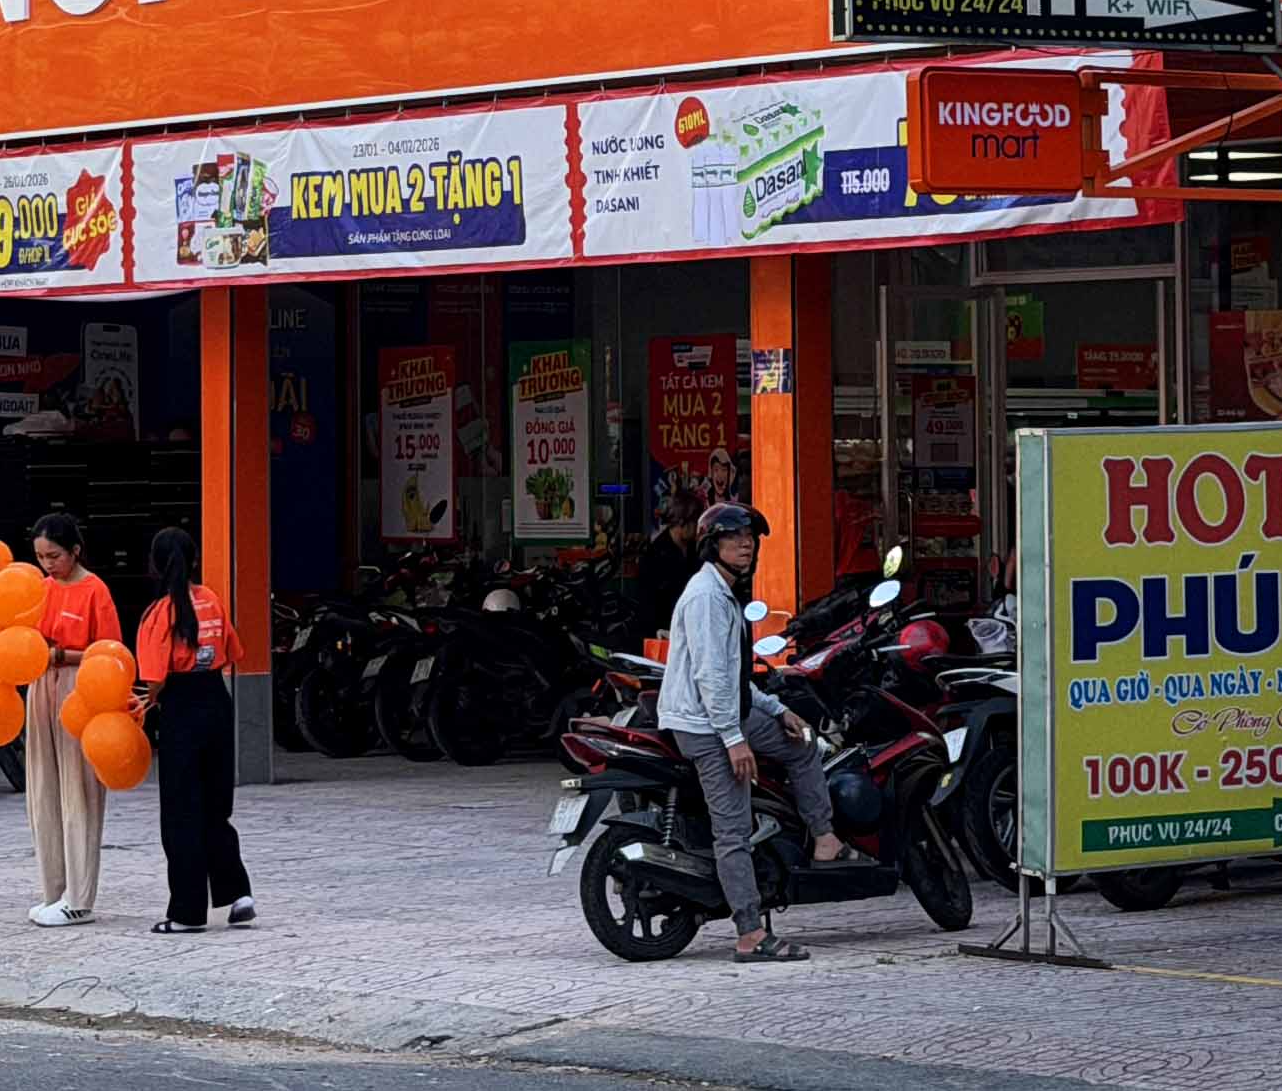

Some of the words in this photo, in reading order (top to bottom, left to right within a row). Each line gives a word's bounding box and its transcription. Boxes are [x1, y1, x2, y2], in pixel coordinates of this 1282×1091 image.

[938, 100, 1071, 128] KINGFOOD
[591, 135, 628, 155] NƯỚC
[971, 132, 1040, 159] mart
[593, 168, 620, 185] TINH
[622, 161, 659, 182] KHIẾT
[290, 170, 344, 220] KEM
[348, 165, 403, 216] MUA
[407, 163, 426, 213] 2
[430, 151, 502, 225] TẶNG
[509, 156, 522, 206] 1
[595, 196, 639, 214] DASANI
[663, 392, 707, 418] MUA
[711, 392, 724, 417] 2
[716, 421, 728, 446] 1
[527, 438, 576, 464] 10.000
[1070, 551, 1281, 664] PHÚ
[1069, 679, 1111, 710] QUA
[1116, 671, 1150, 702] GIỜ
[1164, 673, 1208, 705] QUA
[1210, 664, 1262, 697] NGÀY
[1171, 708, 1213, 736] Có
[1213, 707, 1272, 737] Phòng
[1084, 751, 1189, 799] 100K
[1108, 824, 1153, 846] PHỤC
[1158, 822, 1181, 844] VỤ
[1184, 817, 1233, 840] 24/24
